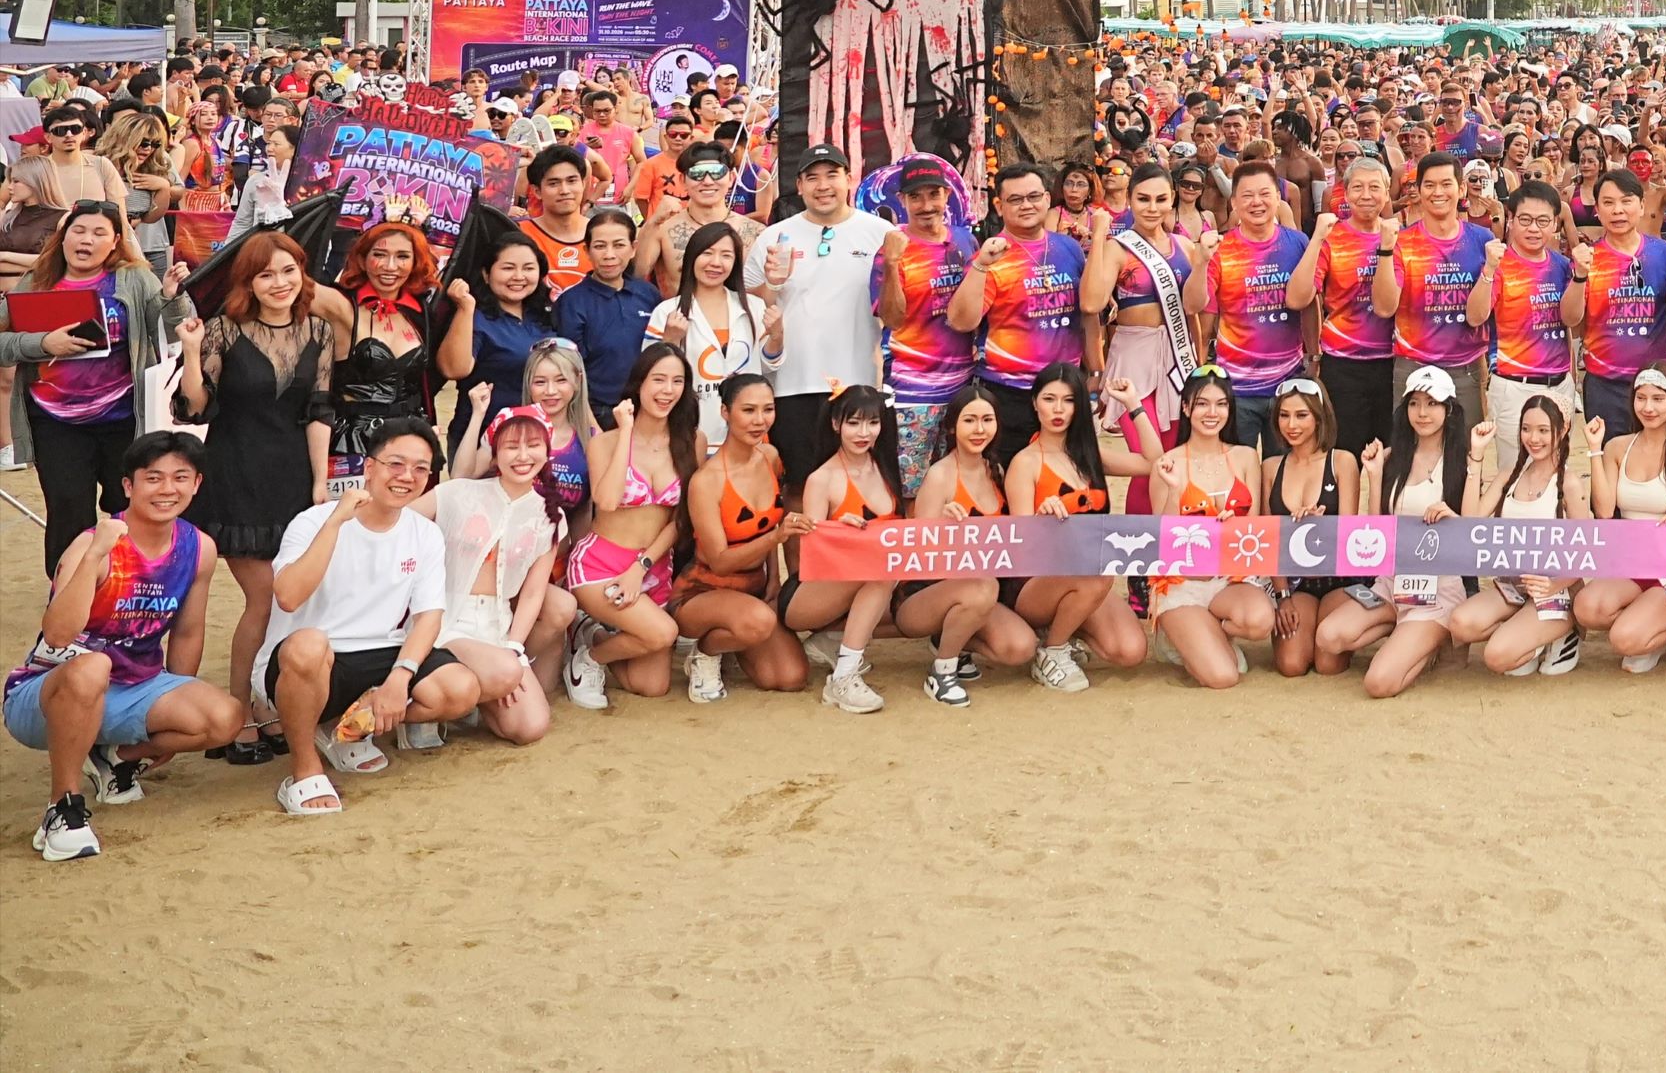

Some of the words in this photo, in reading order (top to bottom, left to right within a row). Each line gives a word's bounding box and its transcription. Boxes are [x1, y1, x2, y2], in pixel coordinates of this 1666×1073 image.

[615, 1, 631, 10] THE
[525, 10, 588, 18] INTERNATIONAL
[490, 60, 528, 75] Route
[530, 55, 557, 68] Map
[329, 125, 484, 189] PATTAYA
[344, 154, 472, 193] INTERNATIONAL
[340, 202, 369, 216] BEA
[429, 216, 461, 236] 2026
[930, 275, 962, 288] PATTA
[1023, 273, 1073, 288] PATAYA
[1245, 272, 1291, 287] PATTAYA
[1424, 272, 1473, 284] PATTAYA
[1529, 291, 1560, 304] PATTAY
[1608, 286, 1655, 298] PATTAYA
[1131, 240, 1155, 260] MISS
[1153, 262, 1174, 289] LGBT
[1165, 293, 1187, 350] CHONBURI
[1180, 353, 1194, 374] 202
[1608, 297, 1655, 305] INTERNATIONAL
[552, 471, 583, 484] TAYA
[880, 523, 1023, 548] CENTRAL
[1471, 524, 1606, 547] CENTRAL
[887, 549, 1013, 573] PATTAYA
[1476, 549, 1597, 571] PATTAYA
[133, 582, 164, 590] CENTRAL
[1402, 578, 1429, 590] 8117
[115, 596, 178, 612] PATTAYA
[111, 611, 174, 620] INTERNATIONA
